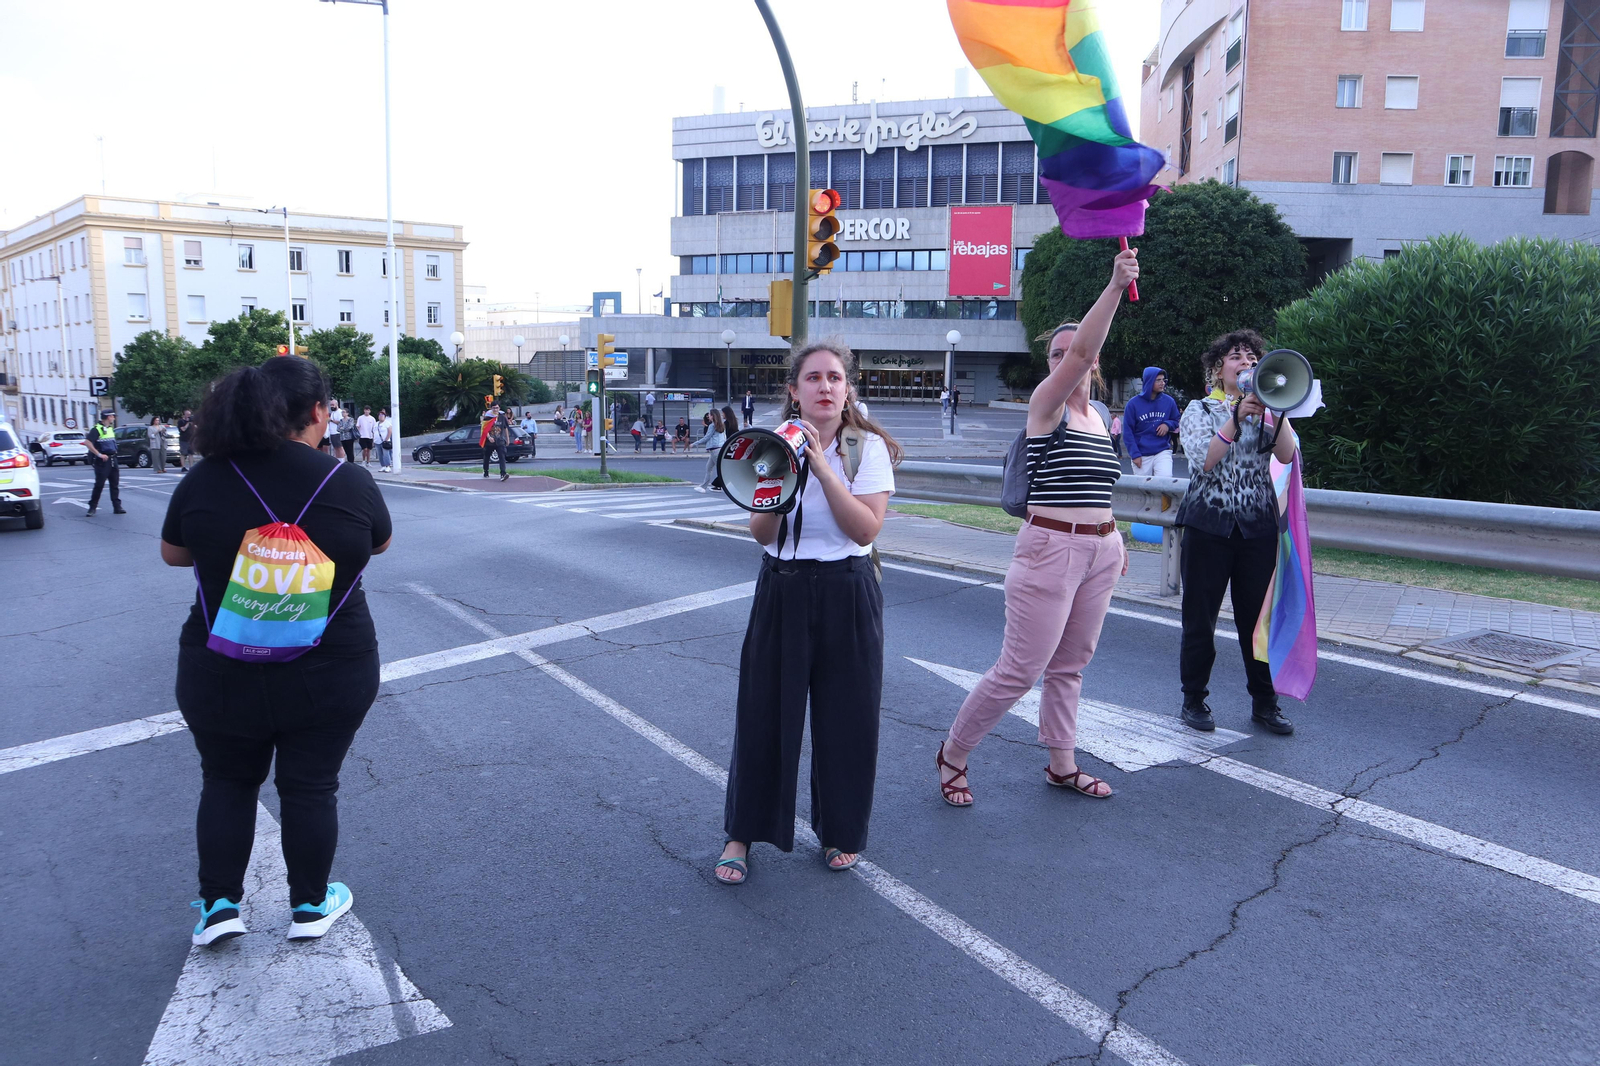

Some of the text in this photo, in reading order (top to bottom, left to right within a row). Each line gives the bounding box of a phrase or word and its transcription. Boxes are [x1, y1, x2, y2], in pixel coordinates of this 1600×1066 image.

[755, 113, 787, 148] El
[864, 99, 978, 155] Inglés
[834, 218, 910, 240] PERCOR
[953, 241, 1008, 258] rebajas
[740, 354, 784, 365] HIPERCOR
[872, 354, 924, 367] El Corte Inglés
[91, 379, 107, 395] P
[726, 437, 746, 459] CGT
[754, 495, 779, 507] CGT
[248, 543, 306, 560] Celebrate
[232, 554, 316, 595] LOVE
[232, 593, 310, 621] everyday
